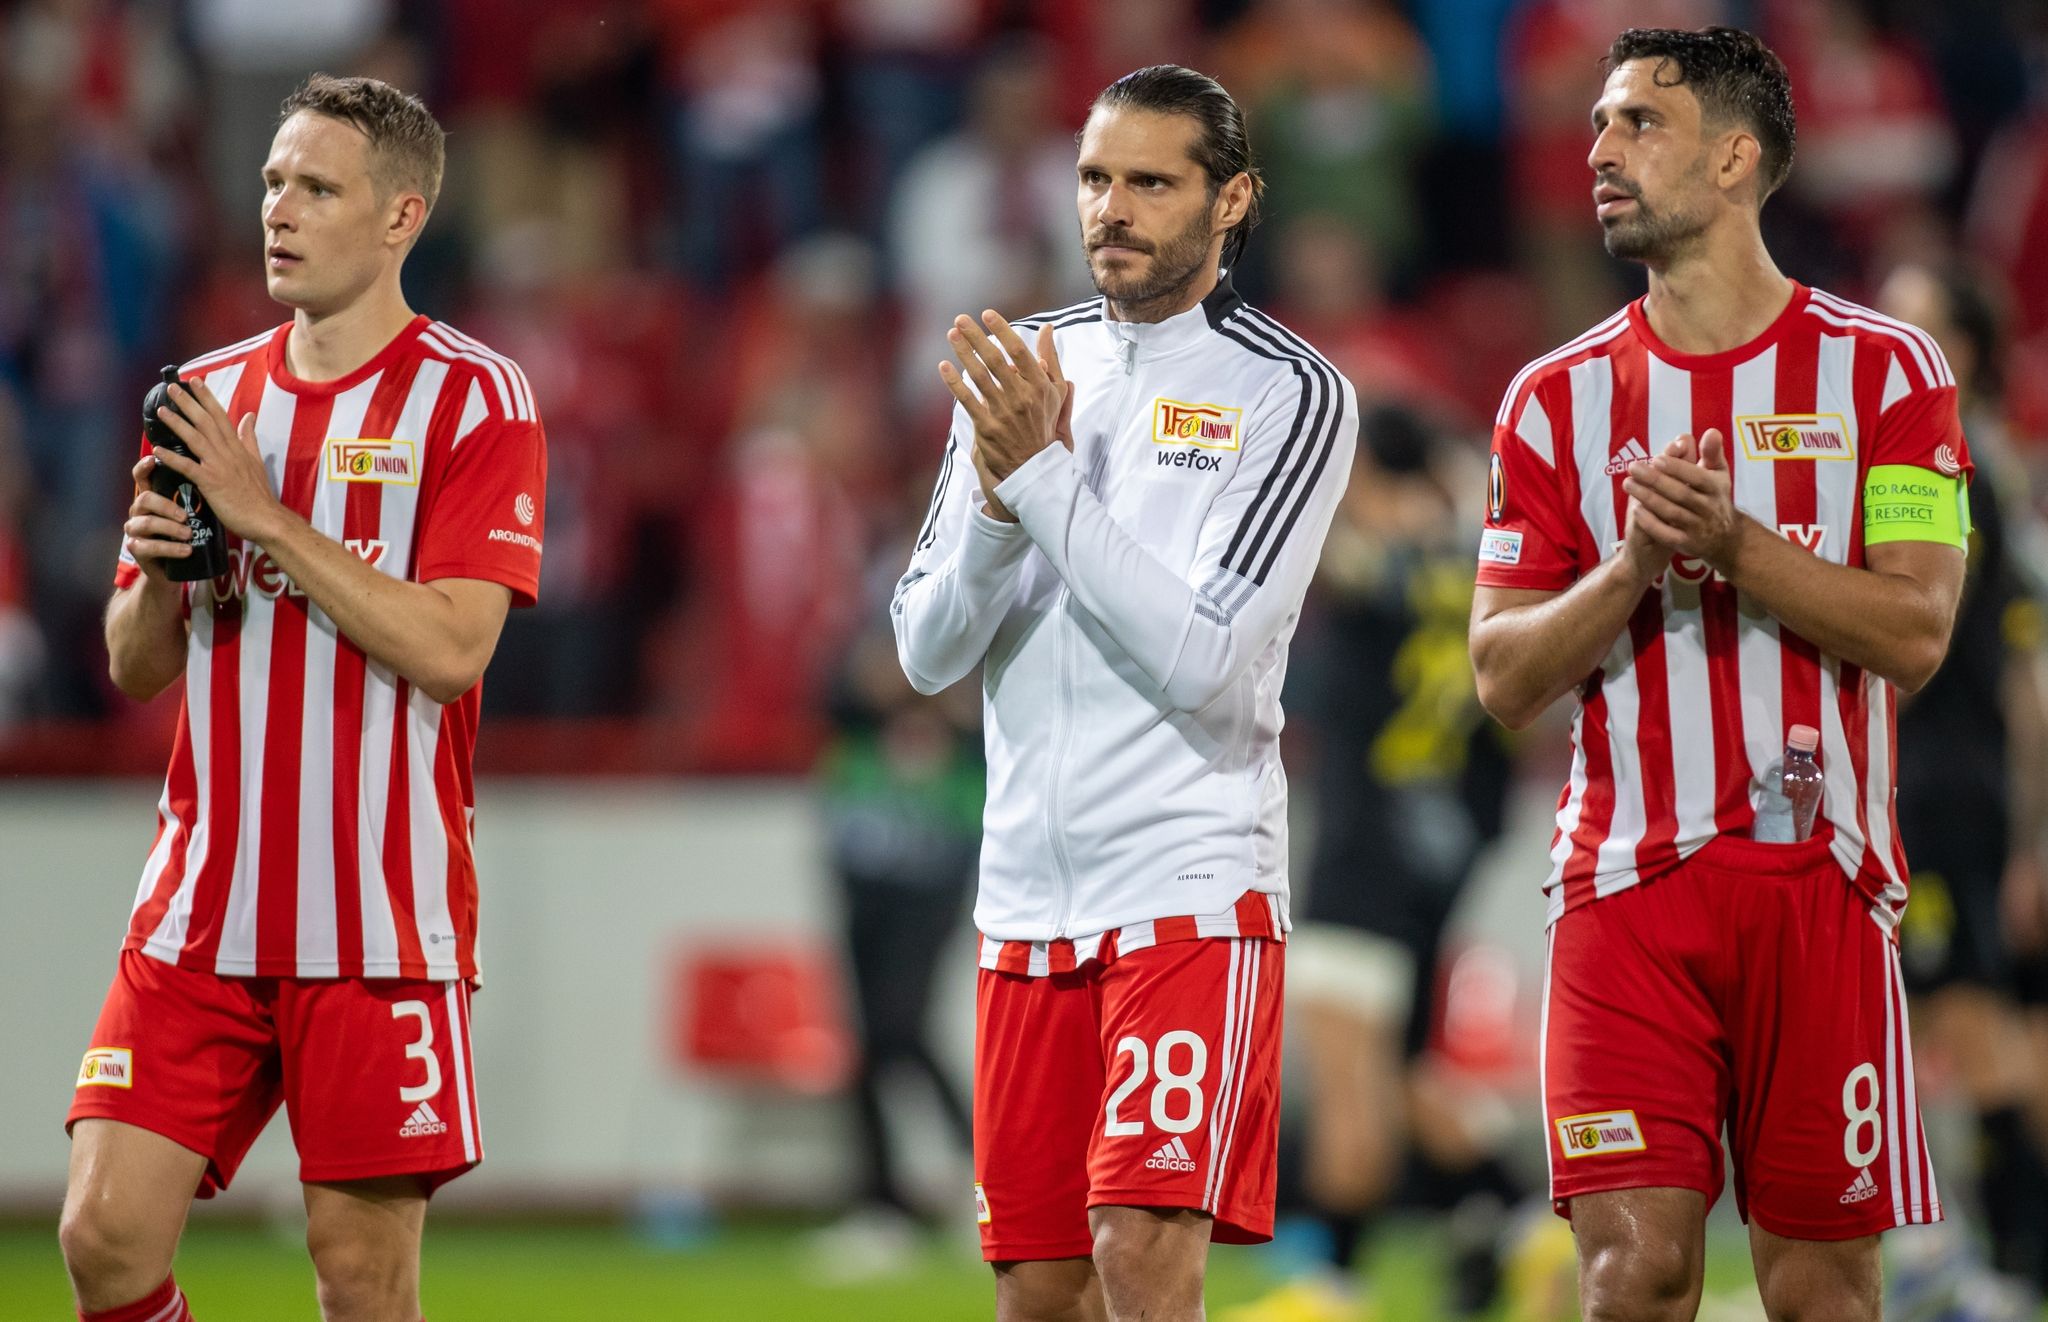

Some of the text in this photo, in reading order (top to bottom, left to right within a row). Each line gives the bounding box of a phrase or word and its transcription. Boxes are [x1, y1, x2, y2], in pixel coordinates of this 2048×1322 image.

[1200, 420, 1232, 440] UNION
[1801, 431, 1842, 449] UNION
[374, 456, 408, 475] UNION
[1157, 448, 1222, 472] wefox
[1870, 484, 1887, 496] TO
[1891, 484, 1939, 498] RACISM
[1875, 507, 1934, 520] RESPECT
[391, 1000, 442, 1102] 3
[1104, 1030, 1208, 1137] 28
[1842, 1062, 1882, 1168] 8
[399, 1121, 448, 1138] adidas
[1600, 1127, 1634, 1144] UNION
[1145, 1157, 1197, 1172] adidas
[1839, 1184, 1879, 1205] adidas
